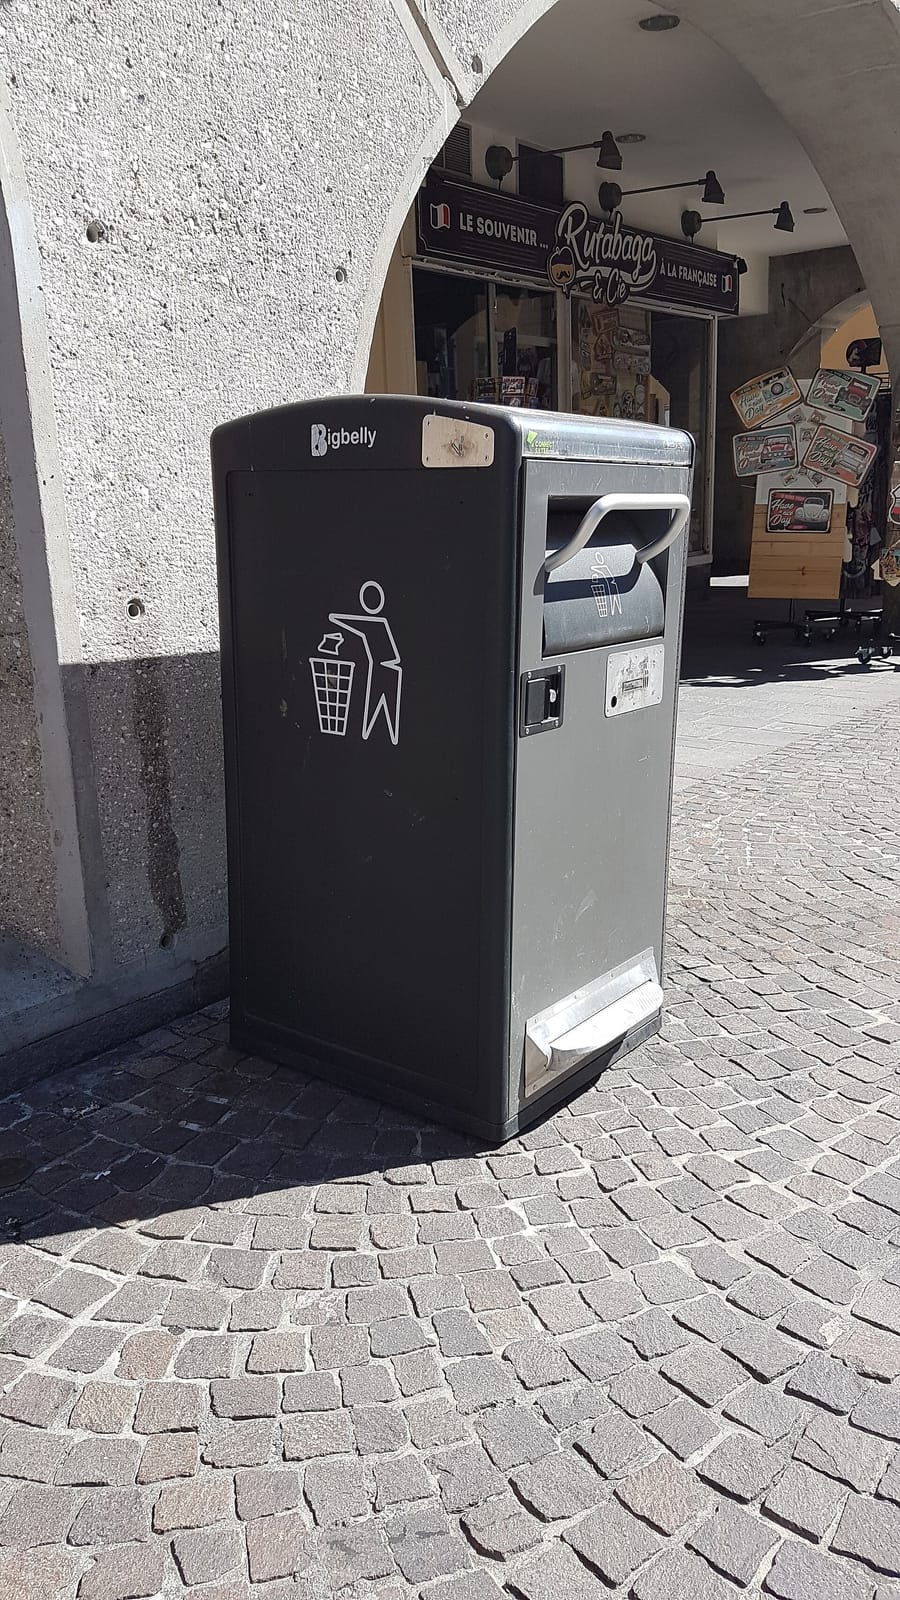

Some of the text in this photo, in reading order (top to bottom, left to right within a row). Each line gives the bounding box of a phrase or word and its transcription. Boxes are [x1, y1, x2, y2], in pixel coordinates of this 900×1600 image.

[459, 212, 473, 233] LE
[557, 202, 657, 281] Rutabaga
[660, 258, 717, 287] À LA FRANÇAISE
[593, 268, 627, 304] & Cie
[311, 423, 377, 457] Bigbelly
[808, 451, 832, 466] Day
[771, 499, 794, 511] Have
[770, 514, 791, 527] Day
